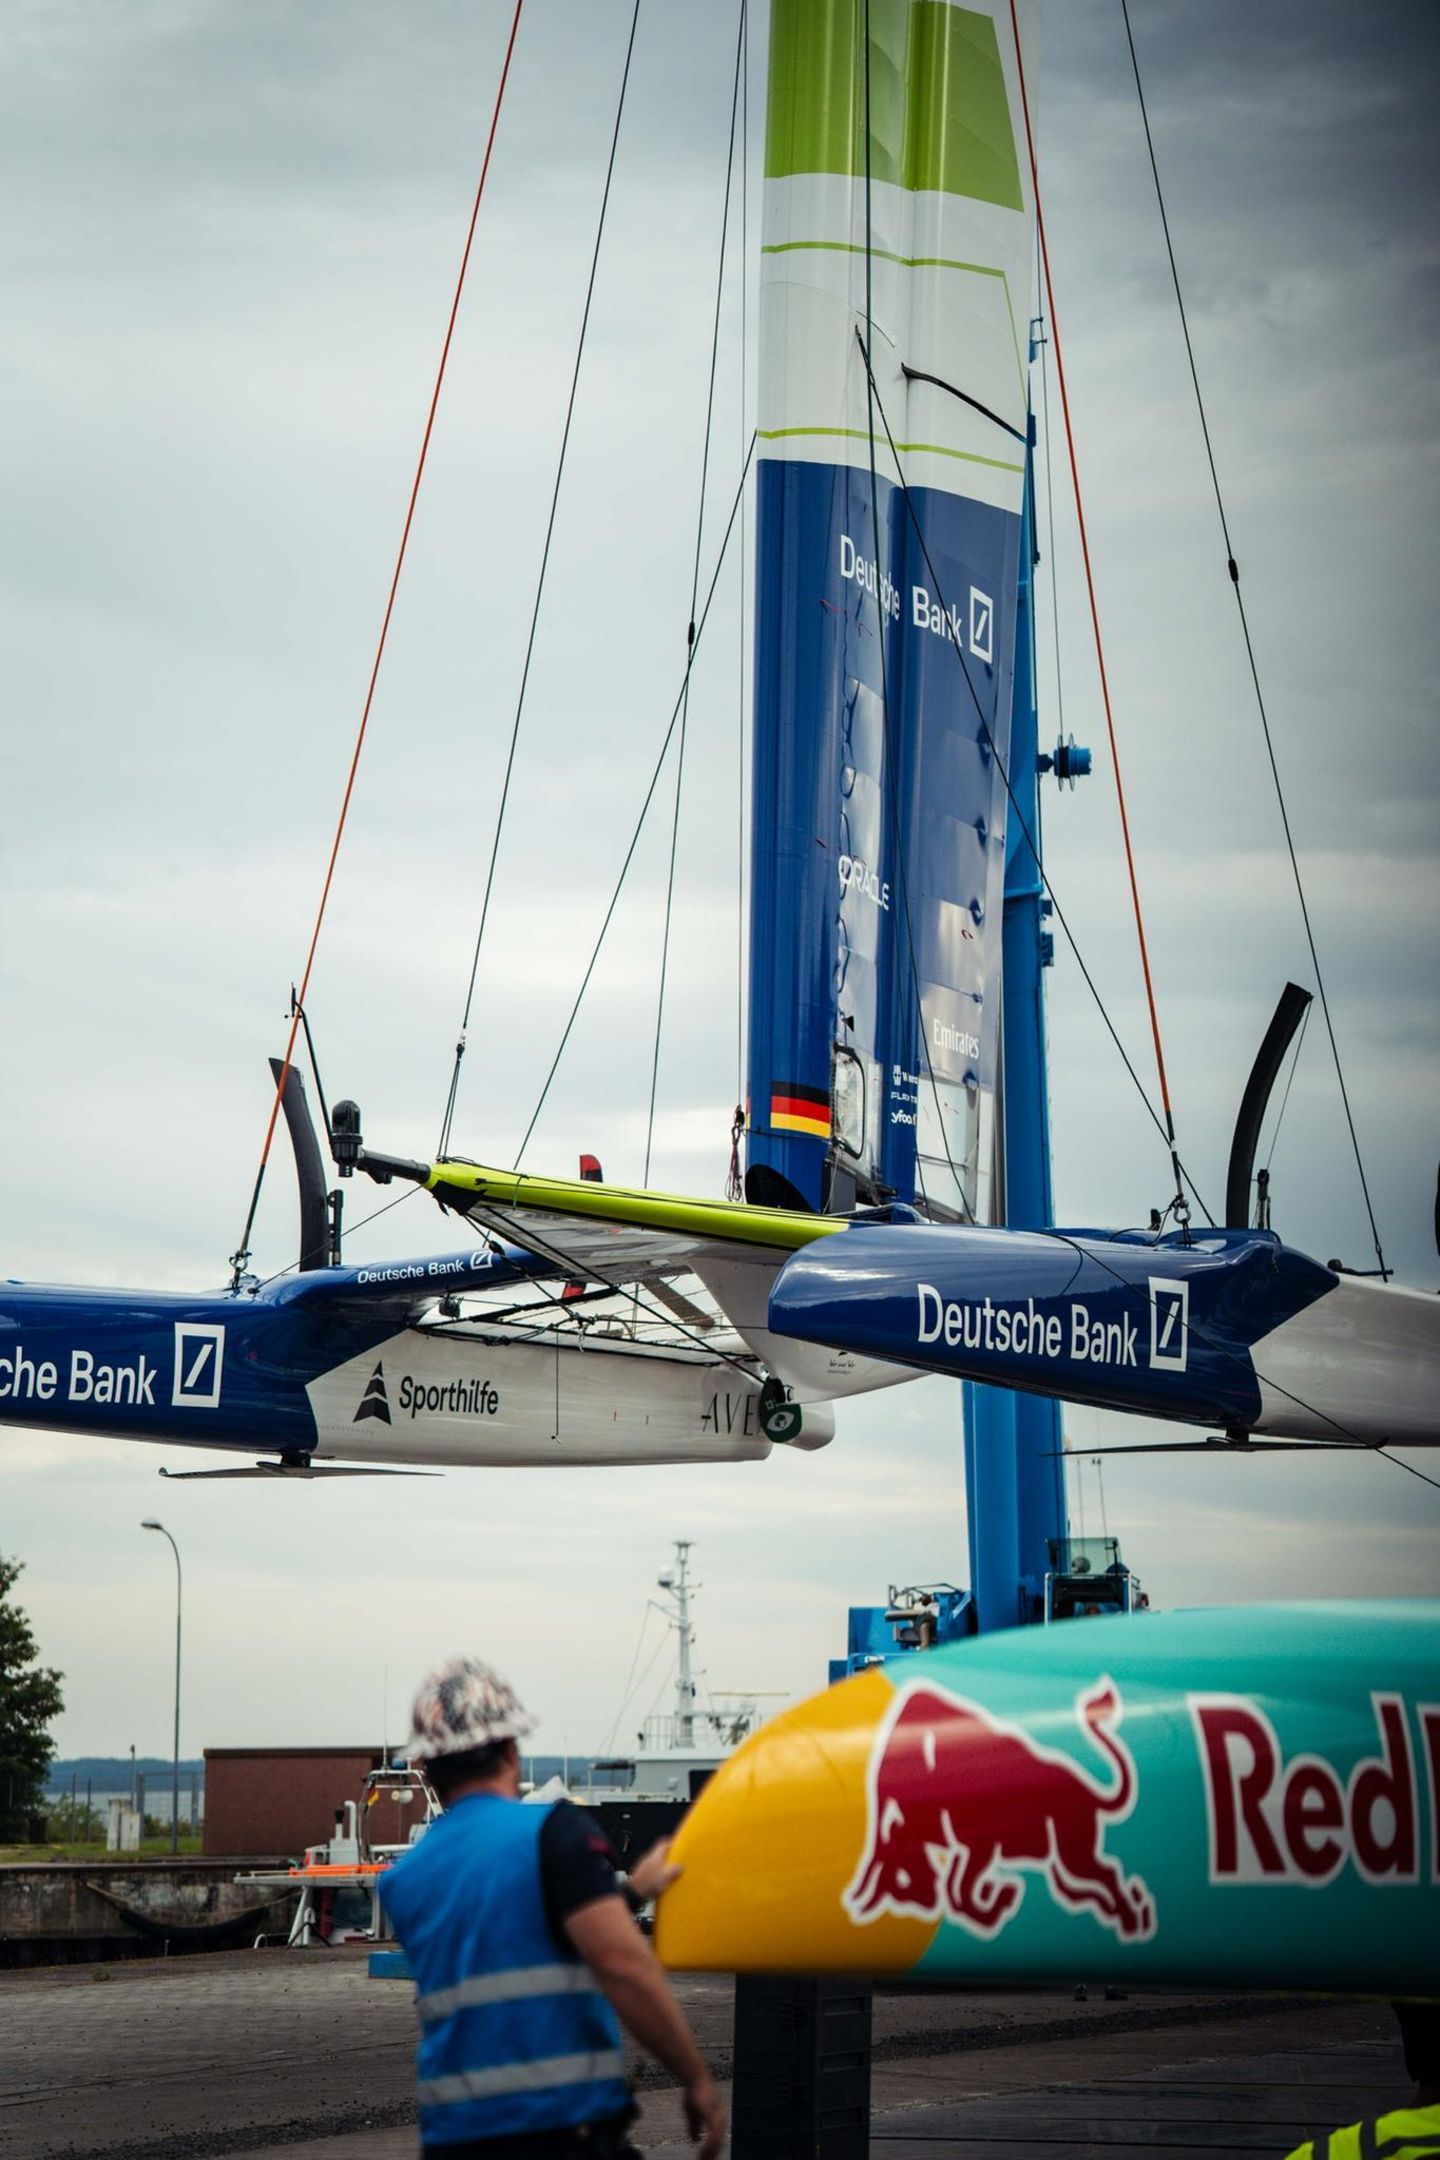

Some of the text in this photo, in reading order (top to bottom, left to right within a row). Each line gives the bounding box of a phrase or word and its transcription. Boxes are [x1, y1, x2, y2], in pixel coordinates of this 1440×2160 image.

[912, 585, 963, 648] Bank
[838, 855, 890, 911] ORACLE
[933, 1018, 979, 1060] Emirates
[357, 1259, 465, 1284] Deutsche Bank
[917, 1283, 1138, 1367] Deutsche Bank
[68, 1349, 158, 1406] Bank
[399, 1375, 499, 1419] Sporthilfe
[701, 1391, 760, 1437] AVE
[1186, 1690, 1421, 1888] Red
